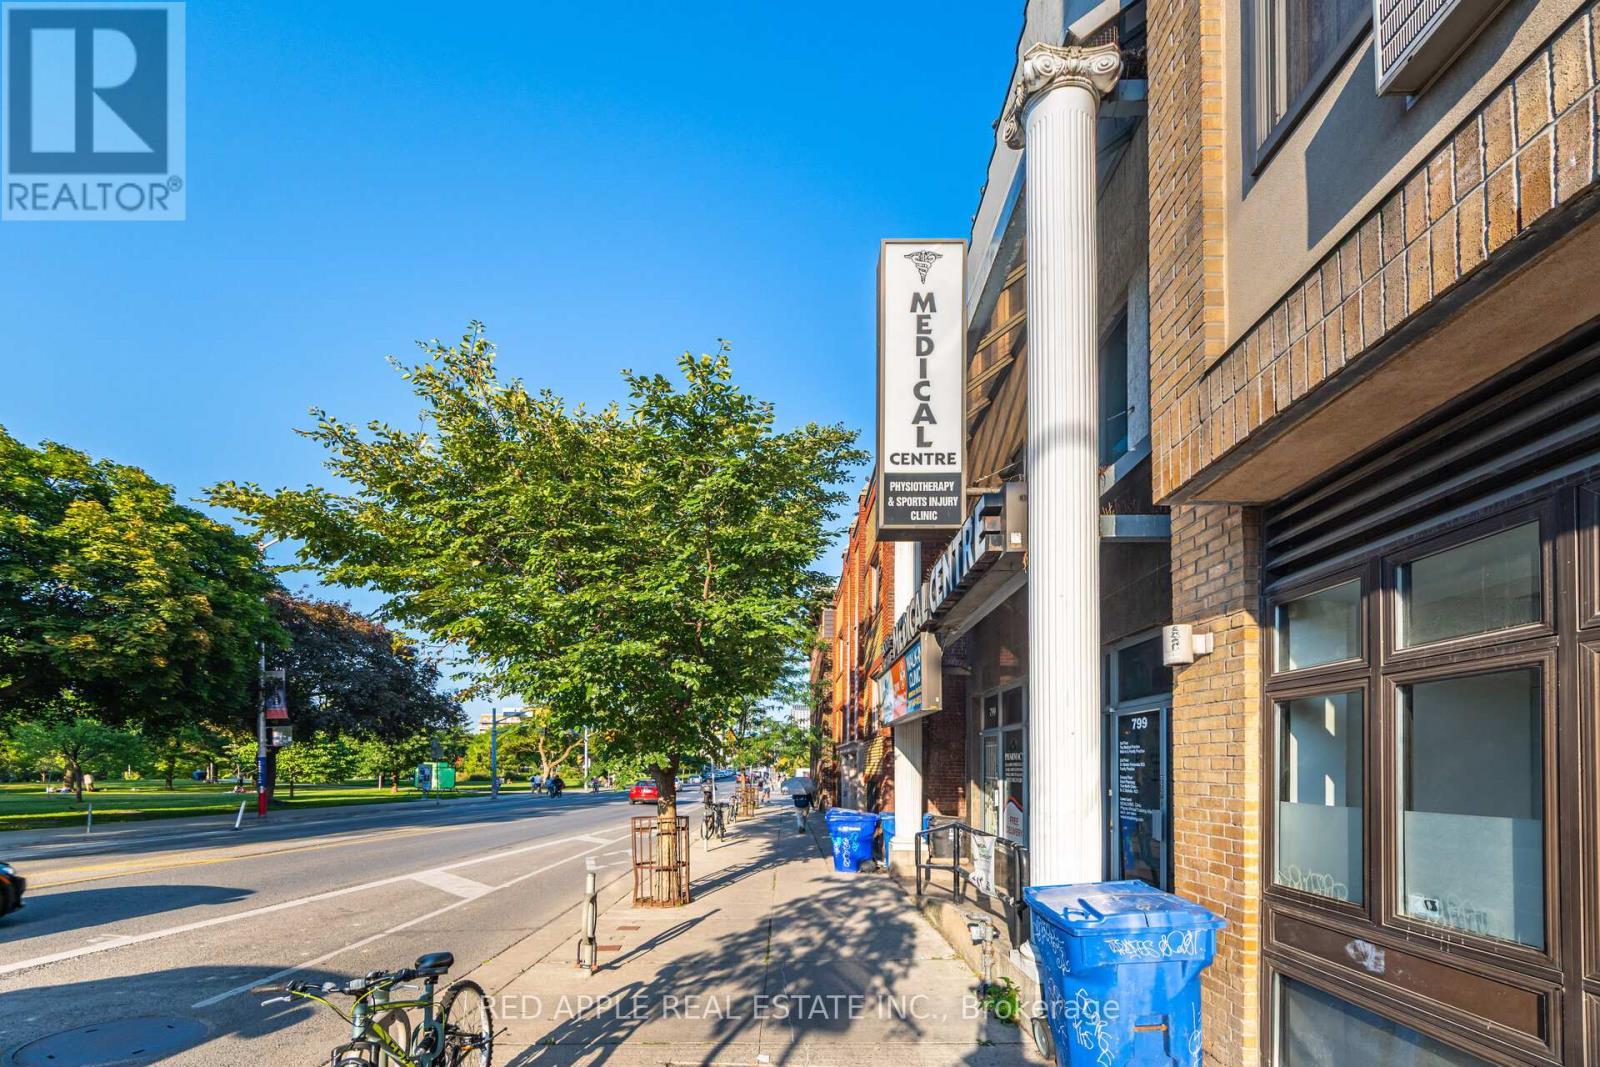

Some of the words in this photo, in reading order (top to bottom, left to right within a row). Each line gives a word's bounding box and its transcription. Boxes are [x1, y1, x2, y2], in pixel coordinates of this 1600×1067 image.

[910, 292, 937, 448] MEDICAL
[889, 452, 957, 466] CENTRE
[889, 481, 955, 492] PHYSIOTHERAPY
[888, 496, 895, 507] &
[896, 496, 927, 507] SPORTS
[928, 496, 959, 507] INJURY
[910, 510, 938, 521] CLINIC
[929, 493, 1003, 614] CENTRE
[1131, 716, 1148, 730] 799
